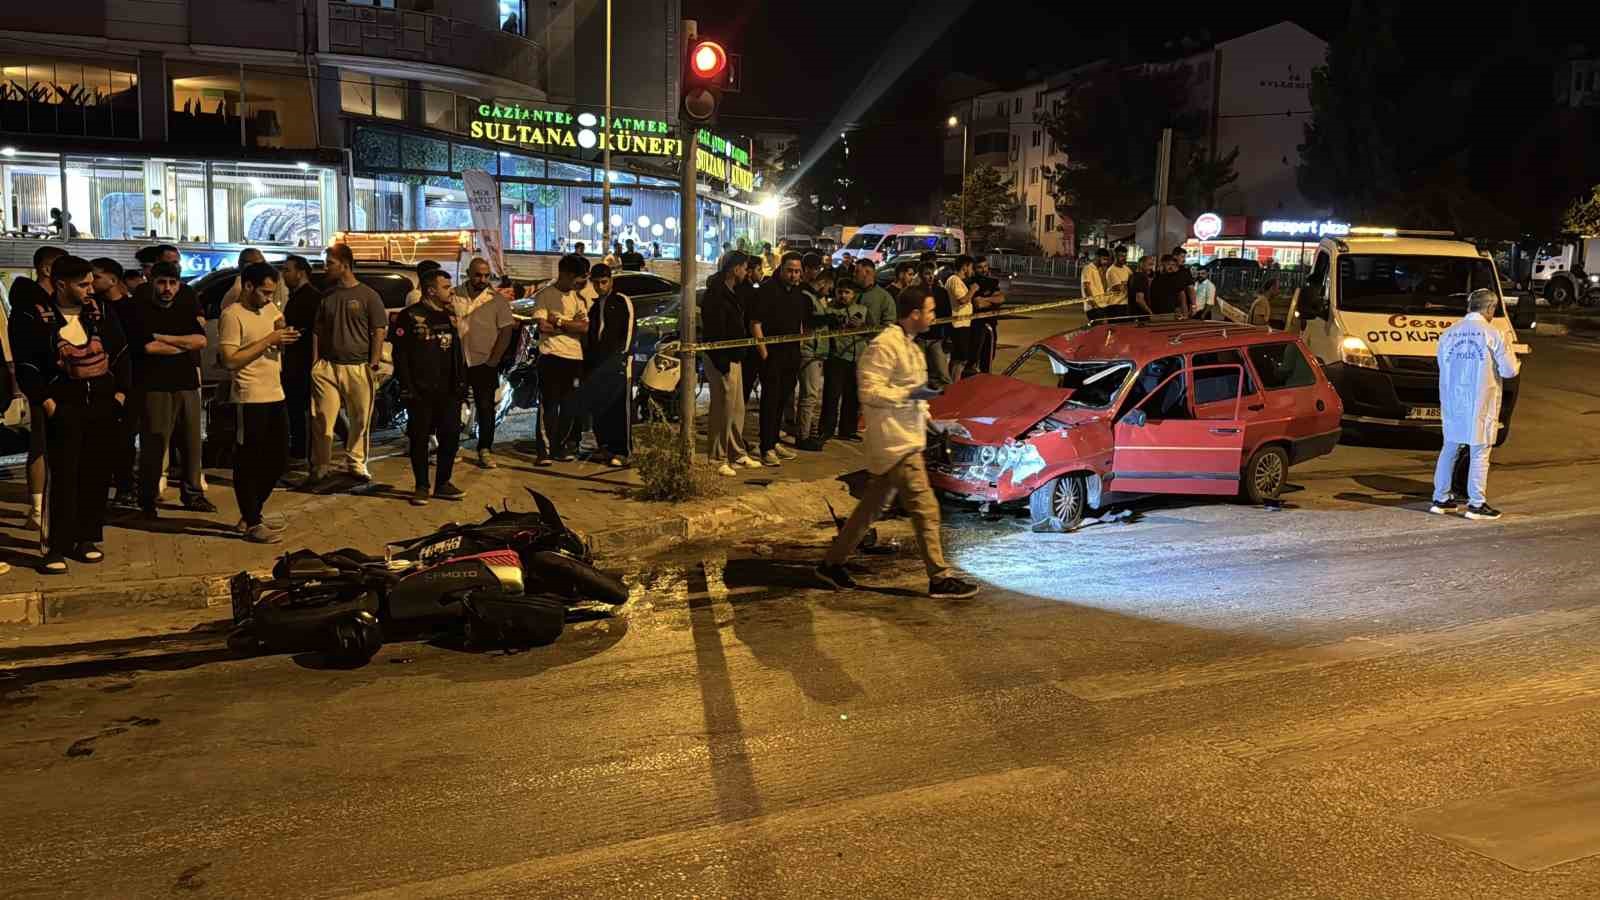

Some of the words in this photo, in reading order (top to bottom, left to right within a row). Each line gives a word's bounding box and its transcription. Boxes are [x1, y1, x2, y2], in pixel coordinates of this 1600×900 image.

[470, 121, 577, 149] SULTANA
[1387, 314, 1453, 329] Cesu
[1367, 330, 1403, 344] OTO
[1406, 331, 1443, 344] KUR
